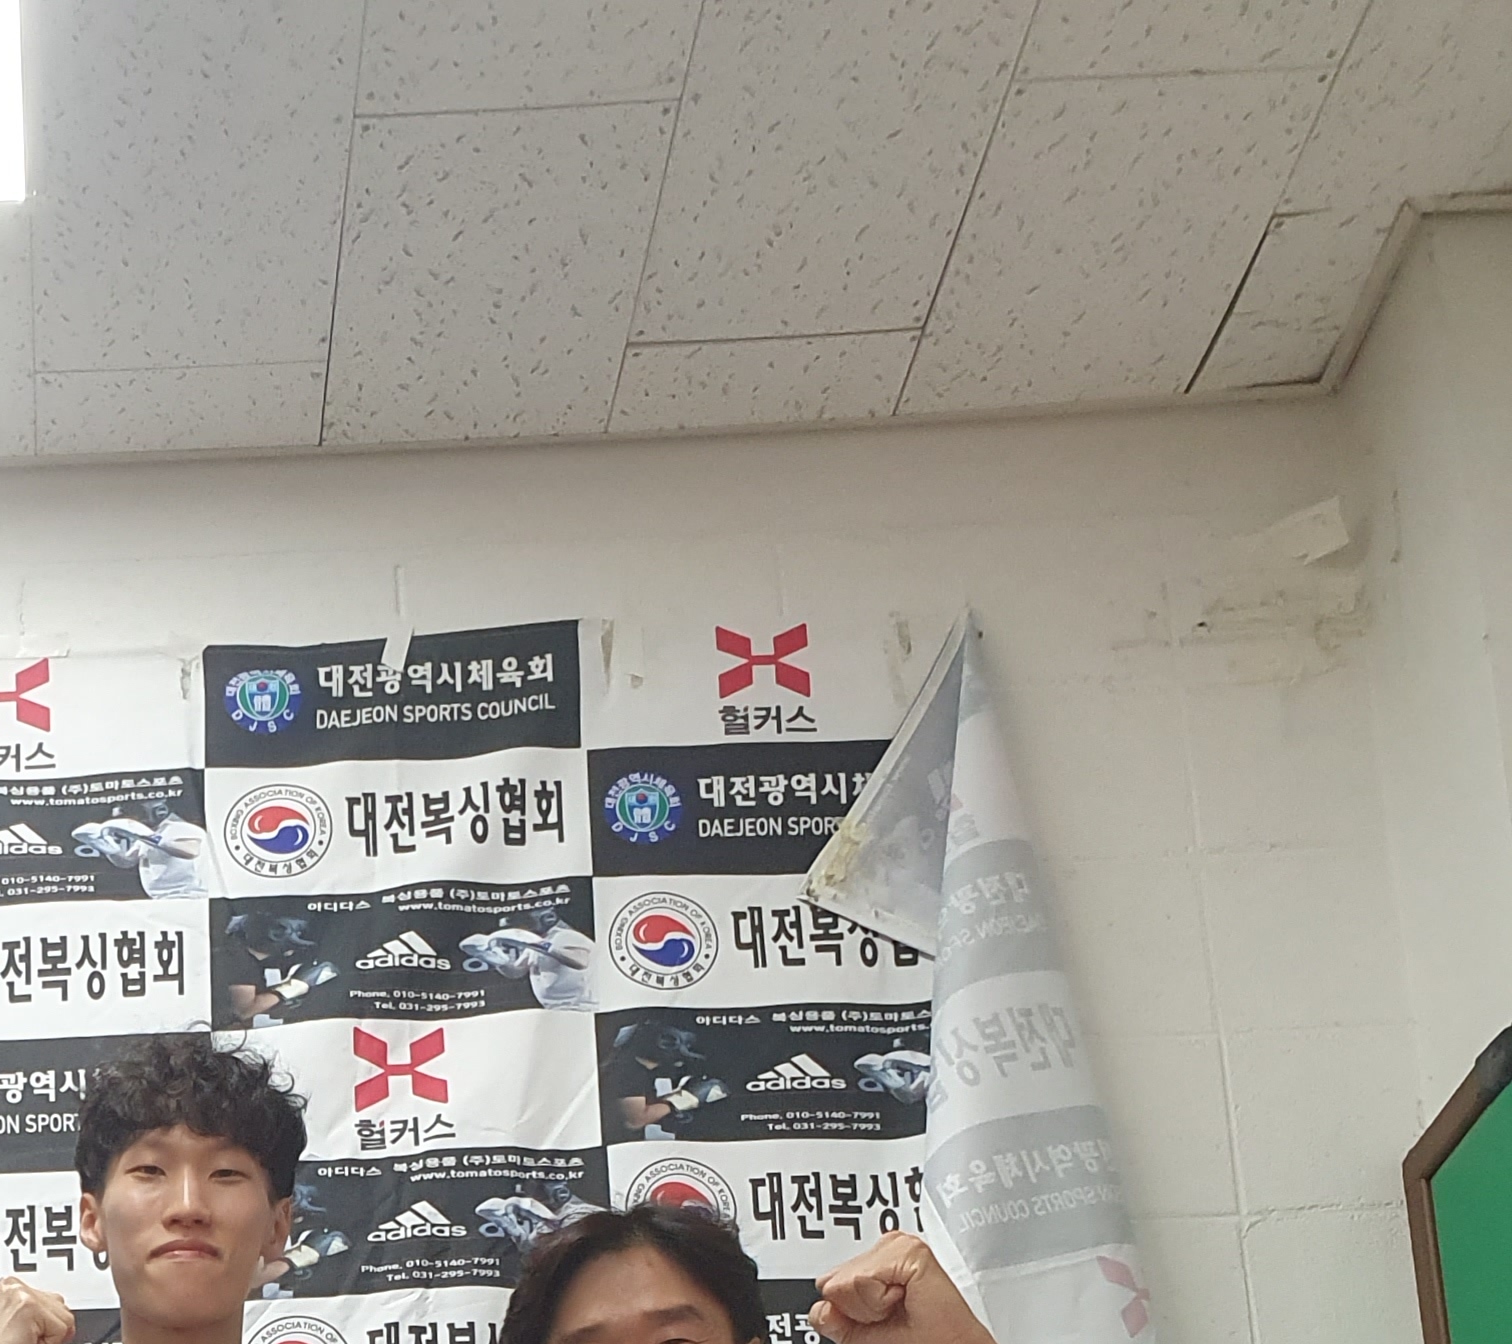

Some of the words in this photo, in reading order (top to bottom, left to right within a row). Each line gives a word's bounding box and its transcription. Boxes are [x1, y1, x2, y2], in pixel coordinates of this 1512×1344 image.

[318, 653, 555, 698] 대전광역시체육회
[316, 705, 398, 729] DAEJEON
[402, 700, 472, 723] SPORTS
[476, 693, 556, 718] COUNCIL
[718, 705, 817, 735] 헐커스
[61, 776, 183, 795] (주)토마토스포츠
[10, 788, 183, 806] www.tomatosports.co.kr
[346, 776, 566, 857] 대전복싱협회
[698, 817, 782, 838] DAEJEON
[1, 874, 95, 886] 010-5140-7991
[7, 885, 95, 897] 031-295-7993
[307, 898, 371, 912] 아디다스
[398, 895, 570, 913] www.tomatosports.co.kr
[356, 954, 450, 970] adidas
[393, 989, 485, 1001] 010-5140-7991
[399, 1000, 486, 1012] 031-295-7993
[696, 1014, 760, 1026] 아디다스
[772, 1009, 836, 1023] 복싱용품
[746, 1076, 846, 1092] adidas
[787, 1110, 880, 1121] 010-5140-7991
[355, 1112, 456, 1151] 헐커스
[793, 1122, 881, 1131] 031-295-7993
[318, 1163, 382, 1179] 아디다스
[393, 1158, 458, 1173] 복싱용품
[410, 1168, 584, 1182] www.tomatosports.co.kr
[749, 1167, 924, 1242] 대전복싱
[367, 1223, 467, 1241] adidas
[405, 1256, 500, 1269] 010-5140-7991
[412, 1268, 500, 1280] 031-295-7993
